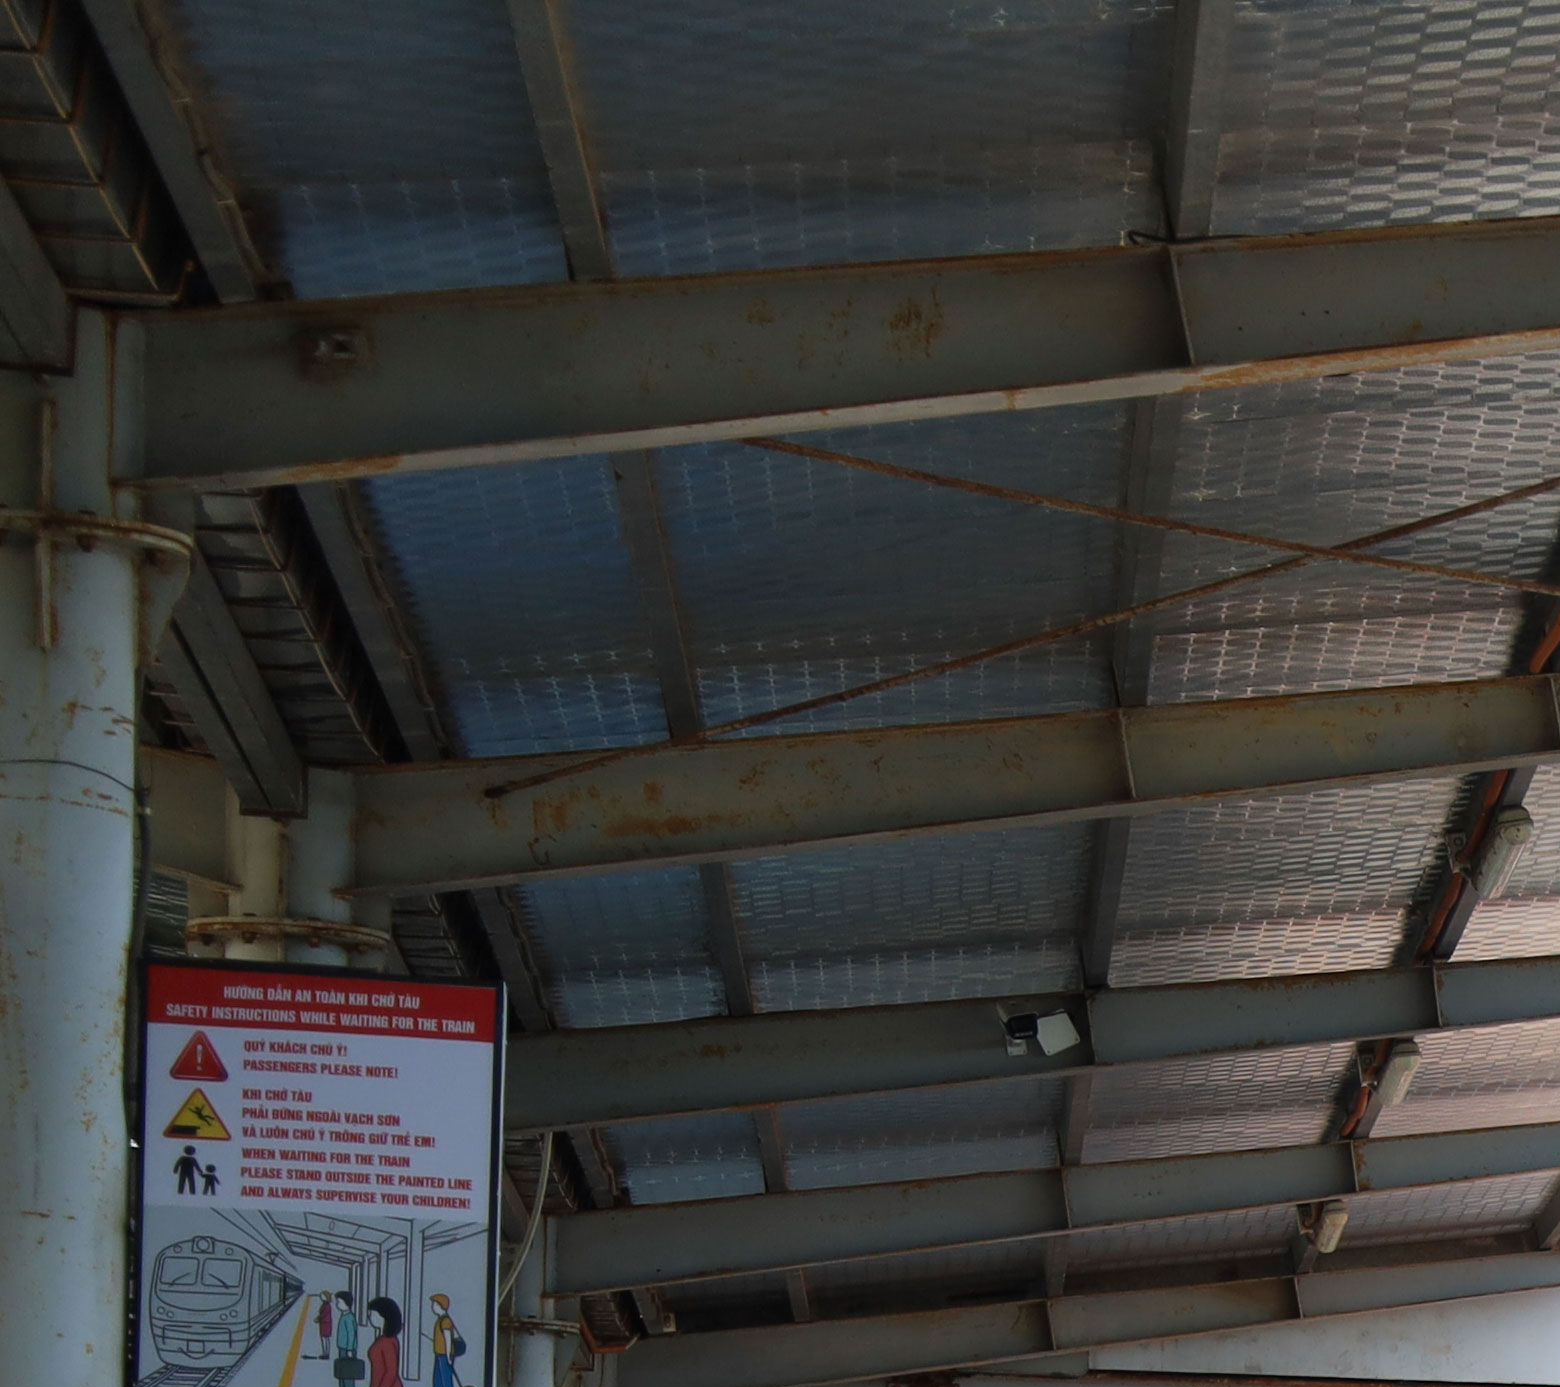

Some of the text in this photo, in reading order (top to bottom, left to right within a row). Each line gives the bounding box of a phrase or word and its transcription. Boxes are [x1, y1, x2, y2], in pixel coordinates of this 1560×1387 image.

[295, 990, 311, 1003] AN
[315, 989, 345, 1005] TOÀN
[349, 994, 367, 1006] KHI
[399, 994, 420, 1009] TÀU
[167, 1003, 475, 1033] SAFETY INSTRUCTIONS WHILE WAITING FOR THE TRAIN
[269, 1041, 306, 1055] KHÁCH
[244, 1059, 398, 1079] PASSENGERS PLEASE NOTE!
[242, 1088, 261, 1100] KHI
[291, 1088, 312, 1103] TÀU
[242, 1104, 268, 1119] PHẢI
[306, 1109, 340, 1124] NGOÀI
[344, 1112, 373, 1127] VẠCH
[242, 1124, 256, 1138] VÀ
[260, 1126, 288, 1139] LUÔN
[293, 1126, 315, 1141] CHÚ
[330, 1129, 364, 1144] TRÔNG
[414, 1135, 435, 1148] EM!
[242, 1148, 410, 1168] WHEN WAITING FOR THE TRAIN
[241, 1167, 472, 1191] PLEASE STAND OUTSIDE THE PAINTED LINE
[241, 1185, 471, 1209] AND ALWAYS SUPERVISE YOUR CHILDREN!
